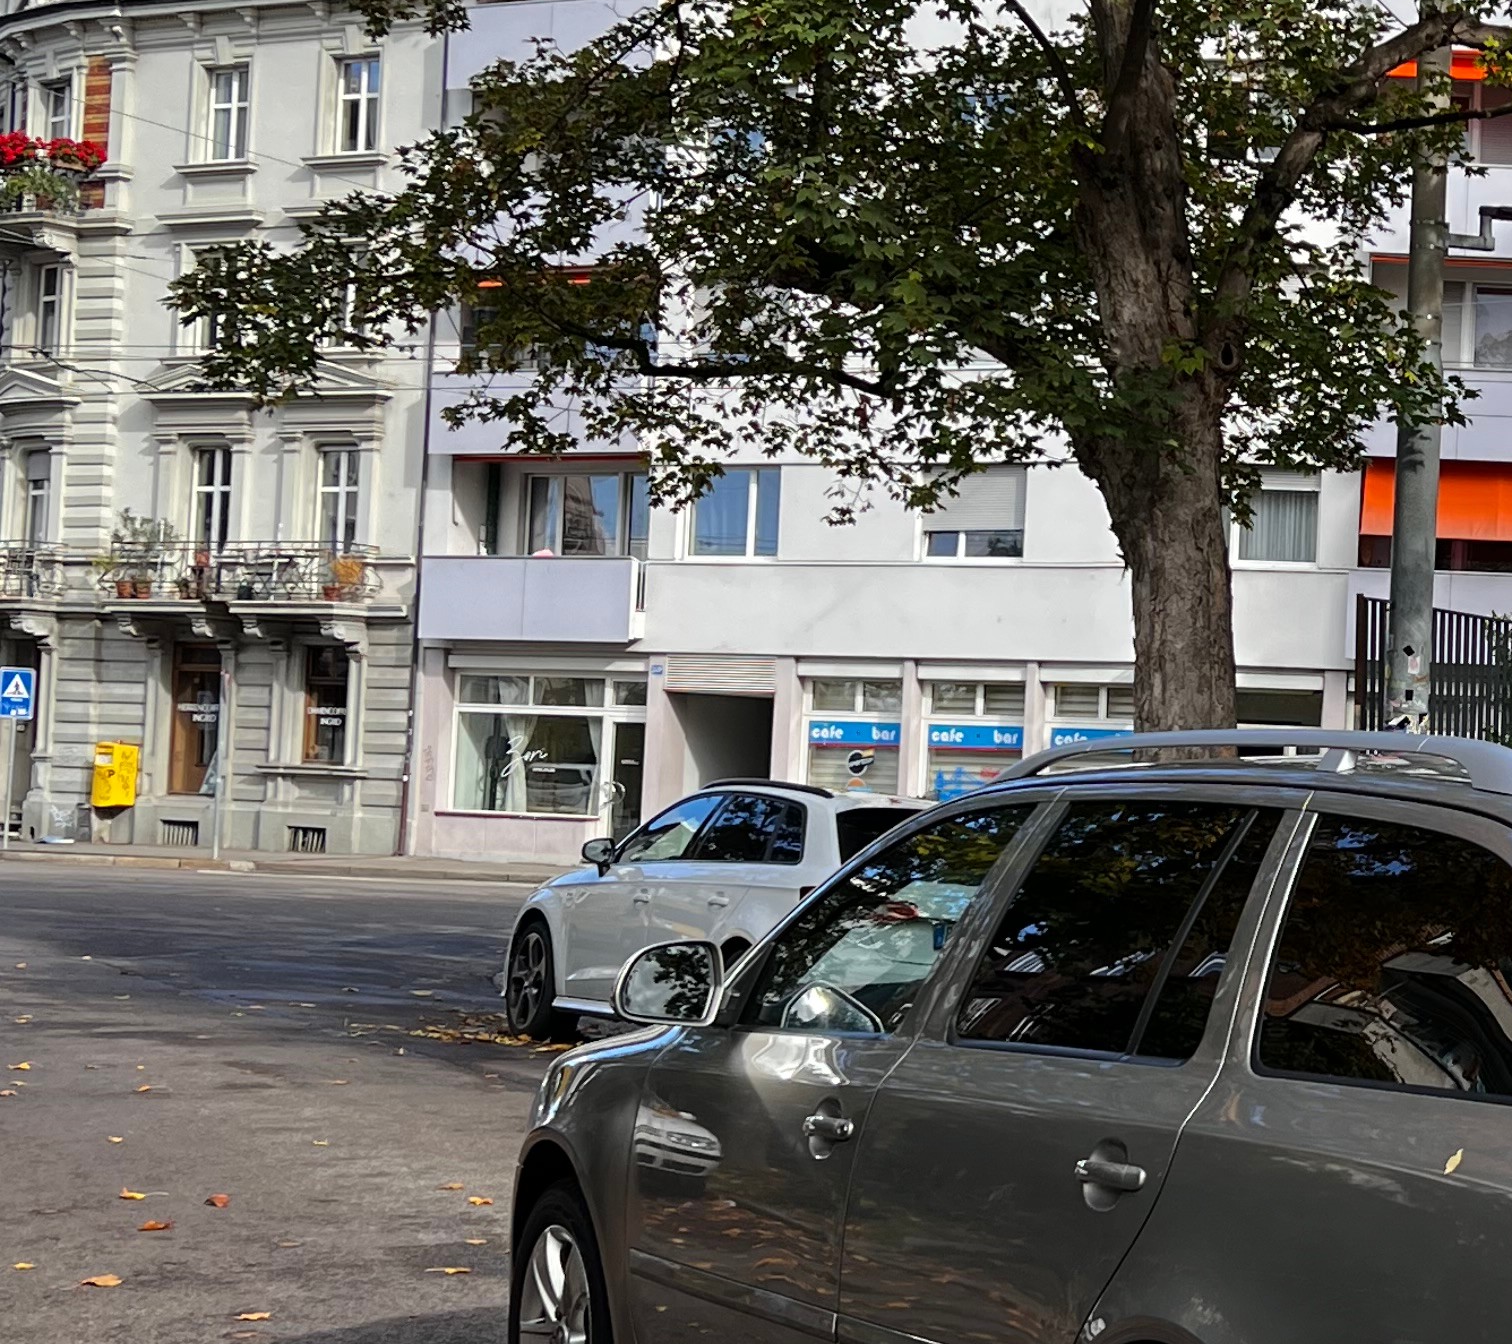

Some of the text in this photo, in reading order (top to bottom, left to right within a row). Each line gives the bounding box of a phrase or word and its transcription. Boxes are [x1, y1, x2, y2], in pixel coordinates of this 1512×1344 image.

[810, 724, 897, 741] cafe bar
[931, 727, 1019, 745] cafe bar
